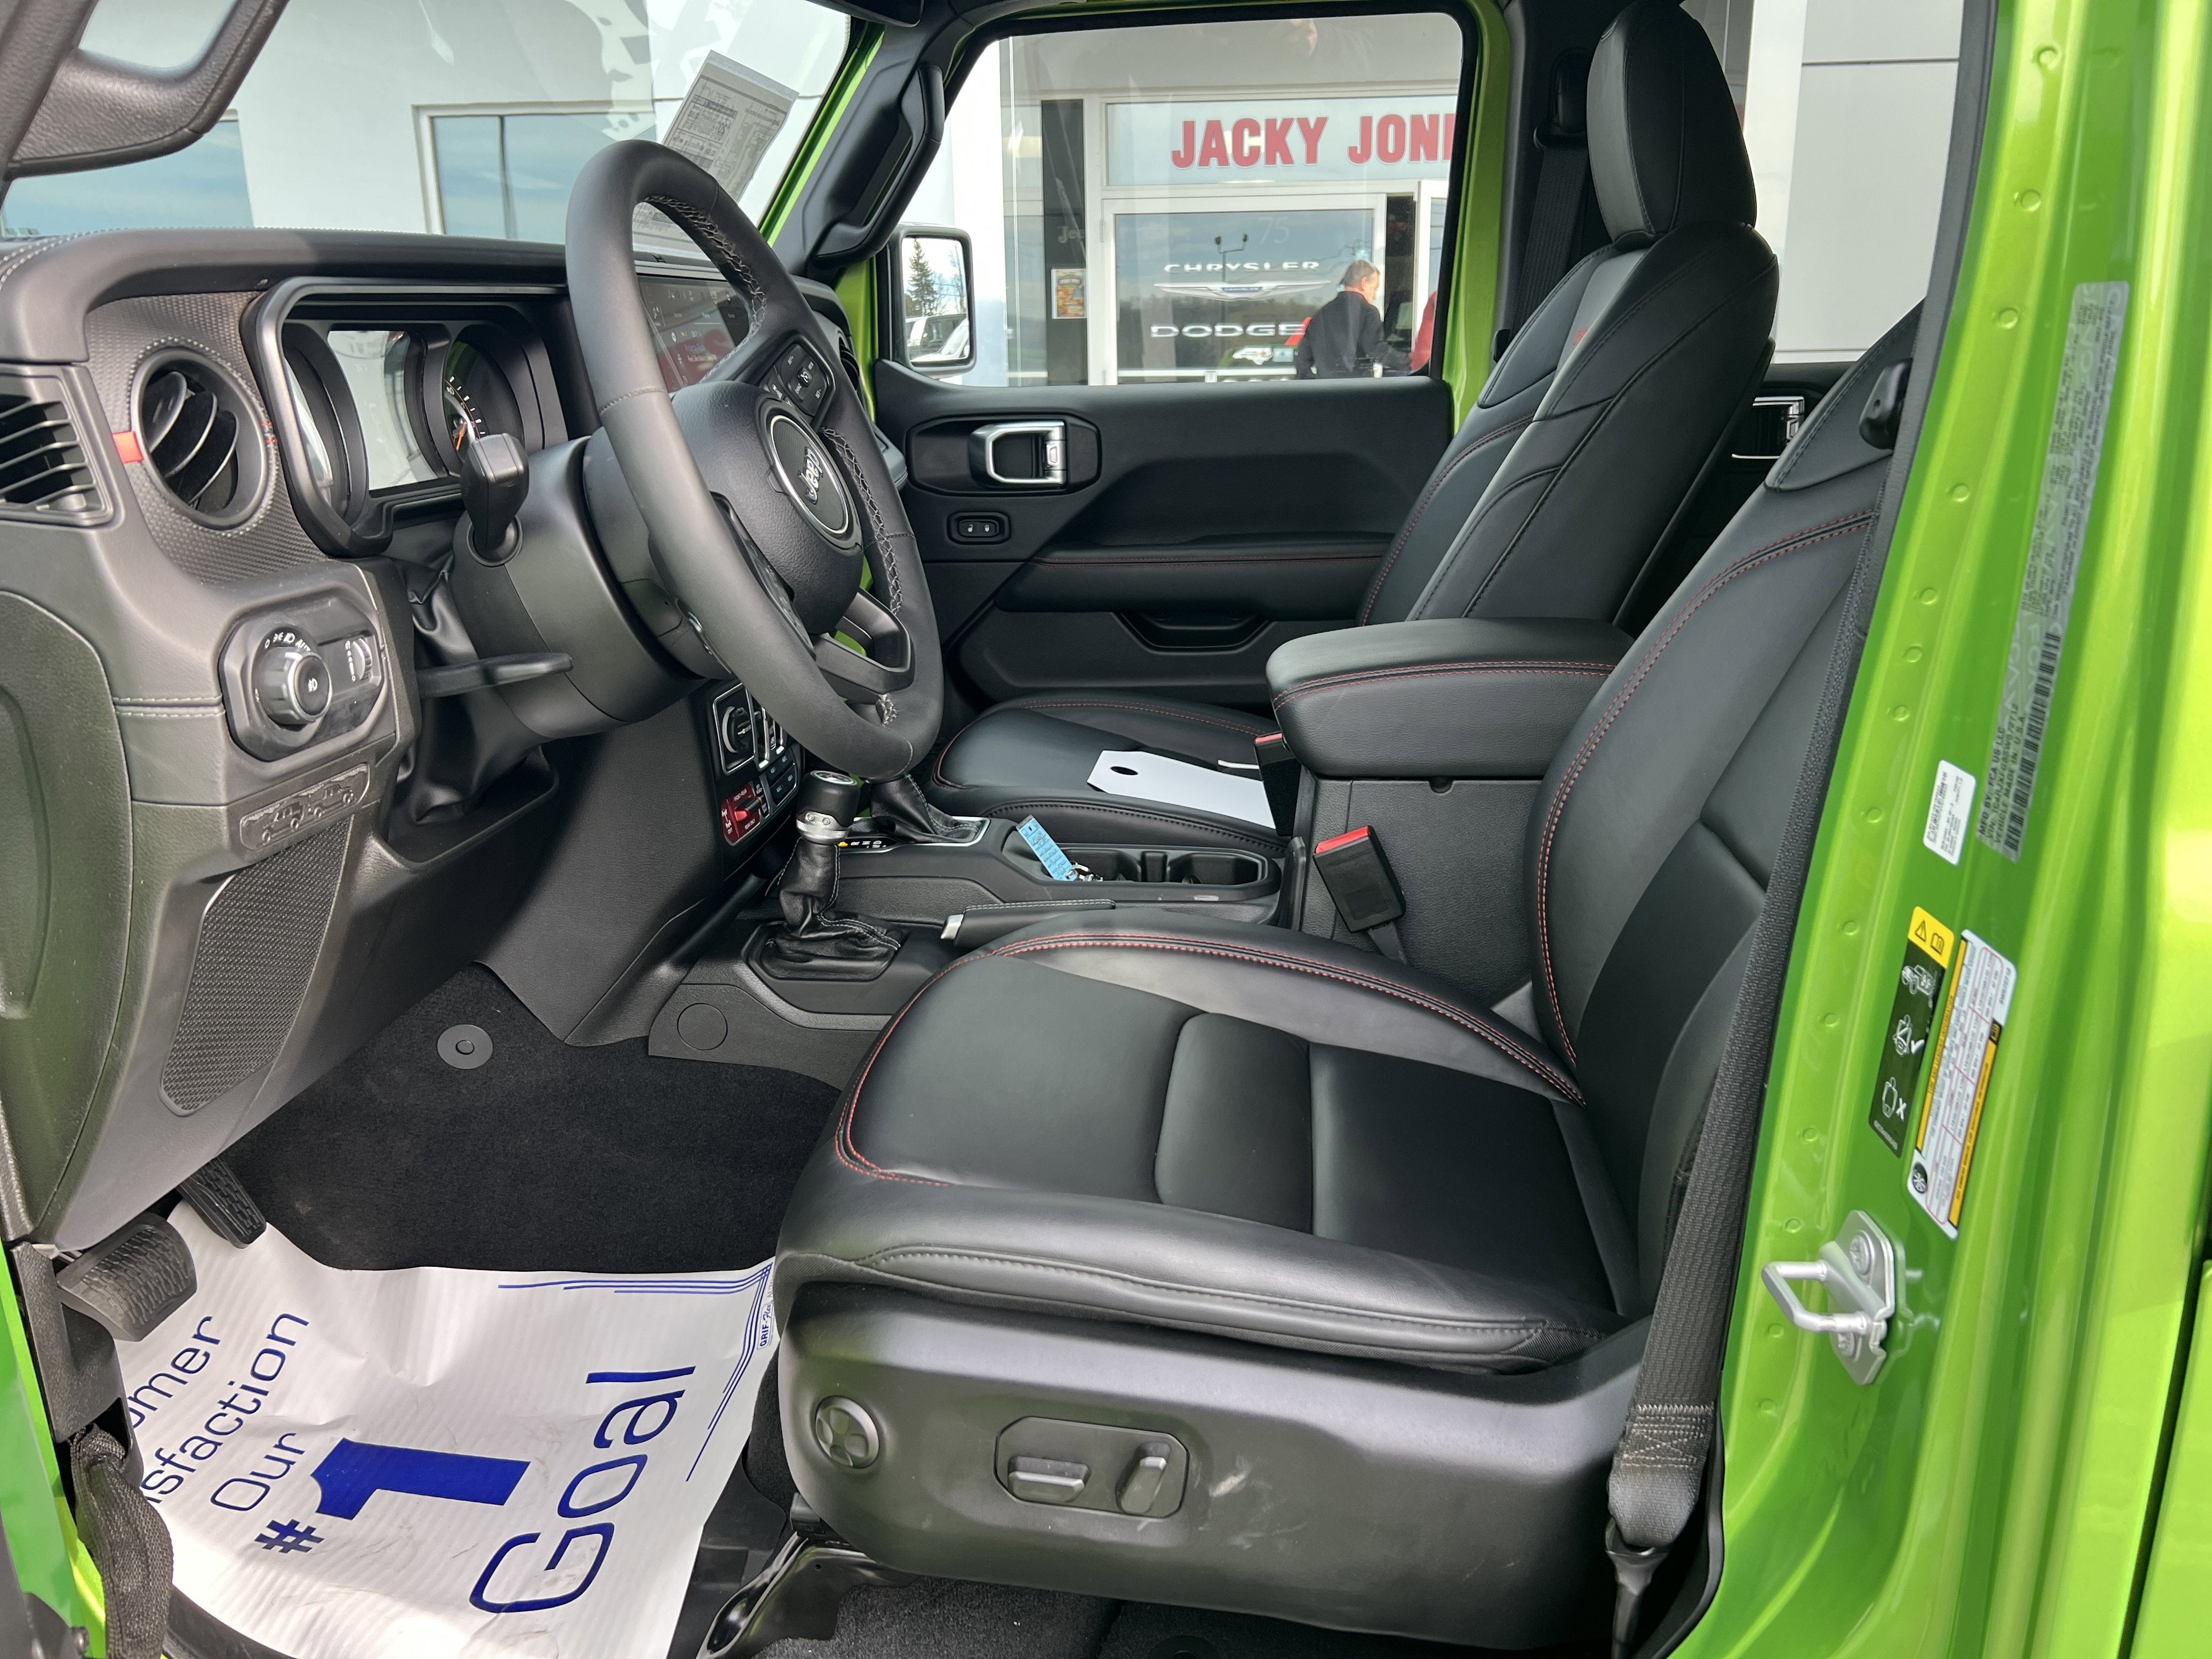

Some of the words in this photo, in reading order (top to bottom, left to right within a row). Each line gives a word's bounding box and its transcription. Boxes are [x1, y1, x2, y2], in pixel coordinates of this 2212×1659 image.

[1171, 116, 1329, 168] JACKY
[1164, 261, 1319, 273] CHRYSLER
[1150, 323, 1306, 337] DODGE
[799, 446, 823, 504] Jeep
[211, 1432, 305, 1511] Our
[469, 1365, 696, 1613] Goal
